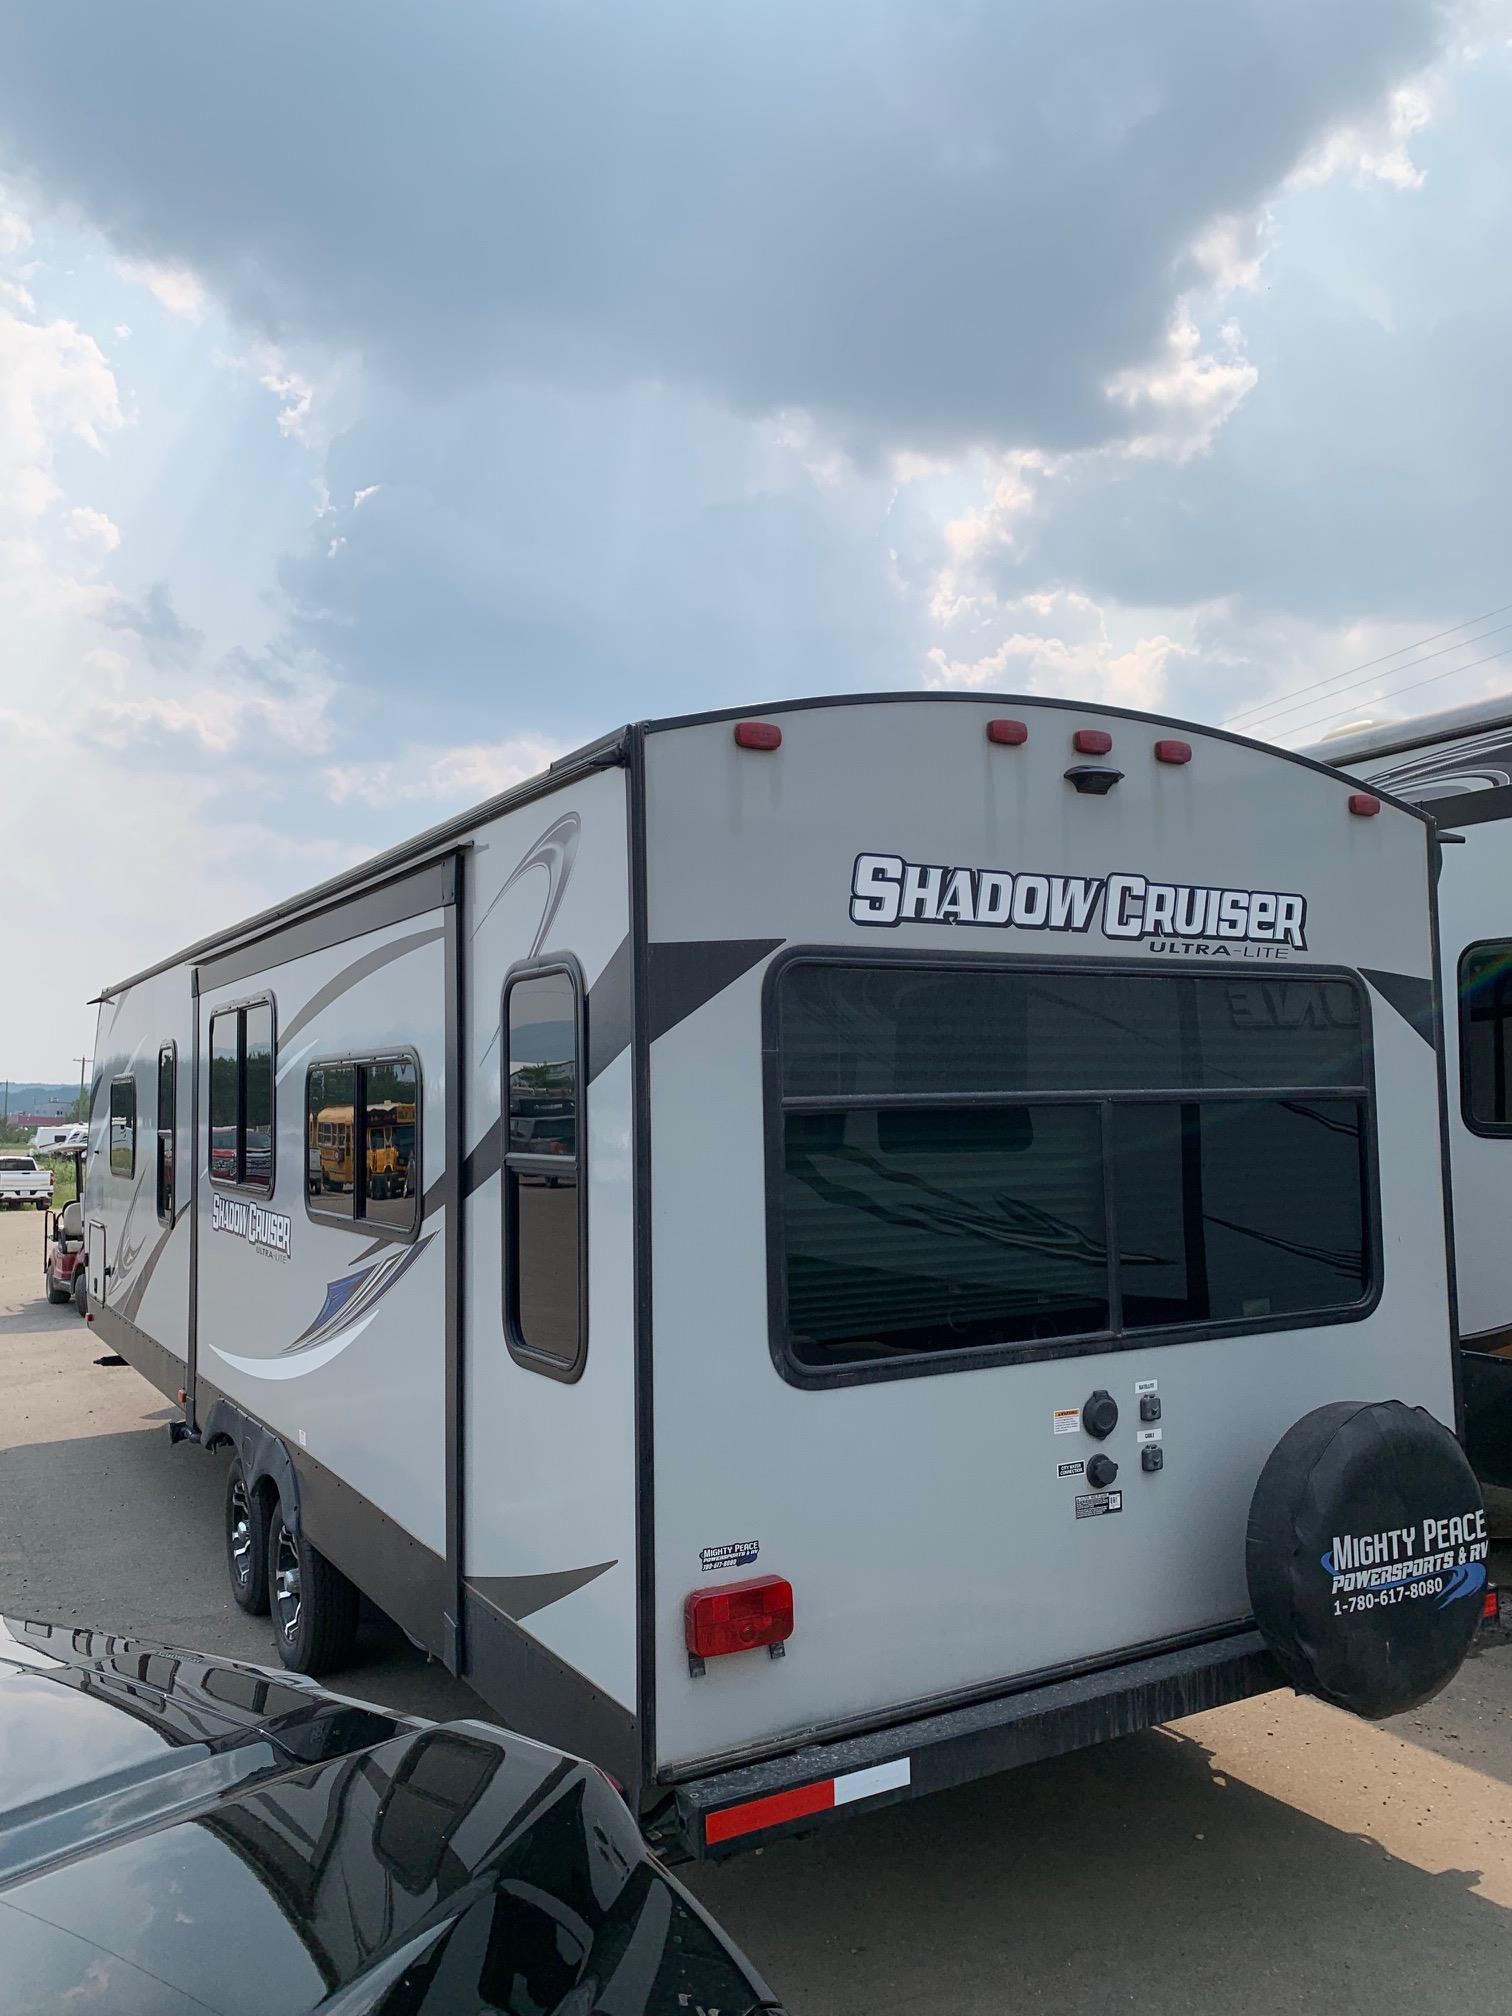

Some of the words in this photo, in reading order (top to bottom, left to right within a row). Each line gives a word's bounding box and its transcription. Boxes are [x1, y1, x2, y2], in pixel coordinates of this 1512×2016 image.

[850, 852, 1104, 933] SHADOW
[1149, 941, 1288, 960] ULTRA-LITE
[213, 1192, 249, 1238] SHADOW
[256, 1245, 287, 1263] ULTRA-LITE
[703, 1546, 733, 1558] MIGHTY
[734, 1541, 758, 1552] PEACE
[1332, 1526, 1416, 1571] MIGHTY
[1423, 1509, 1487, 1552] PEACE
[1331, 1551, 1454, 1594] POWERSPORTS
[1458, 1547, 1467, 1565] &
[1470, 1540, 1489, 1563] RV
[1333, 1577, 1443, 1616] 1-780-617-8080
